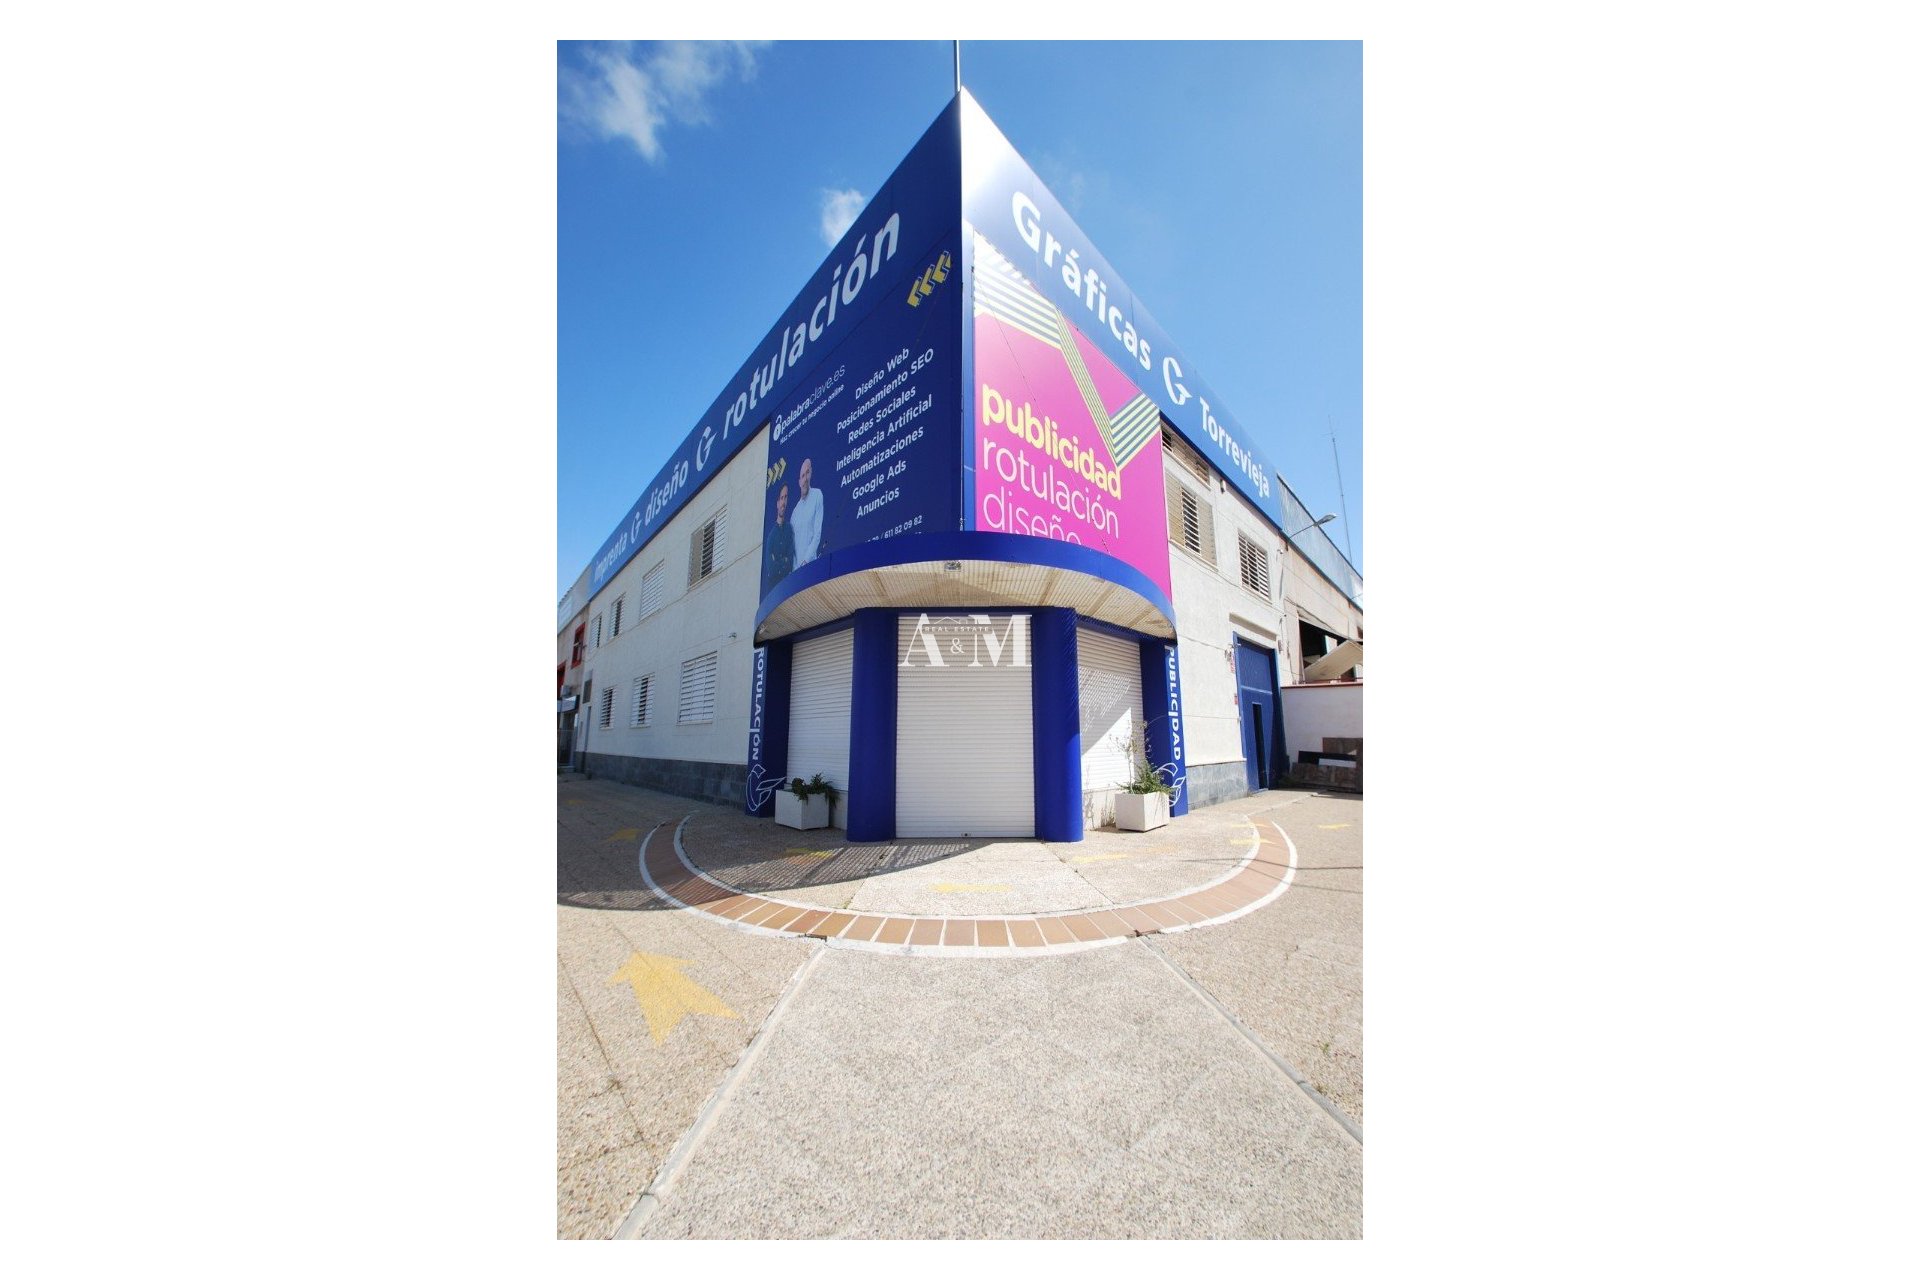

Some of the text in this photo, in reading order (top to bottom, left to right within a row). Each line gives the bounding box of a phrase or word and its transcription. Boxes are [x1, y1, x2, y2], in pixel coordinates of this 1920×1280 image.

[645, 460, 689, 526] diseño
[722, 212, 900, 440] rotulación
[855, 348, 909, 400] Diseño Web
[1012, 191, 1151, 371] Gráficas
[1200, 397, 1270, 498] Torrevieja
[837, 348, 934, 433] Posicionamiento SEO
[848, 386, 916, 443] Redes Sociales
[836, 394, 932, 471] Inteligencia Artificial
[840, 426, 924, 488] Automatizaciones
[982, 383, 1122, 500] publicidad
[852, 460, 907, 500] Google Ads
[856, 487, 900, 519] Anuncios
[983, 437, 1119, 539] rotulación
[884, 529, 894, 539] 611
[750, 647, 765, 761] ROTULACIÓN
[1164, 645, 1181, 761] PUBLICIDAD
